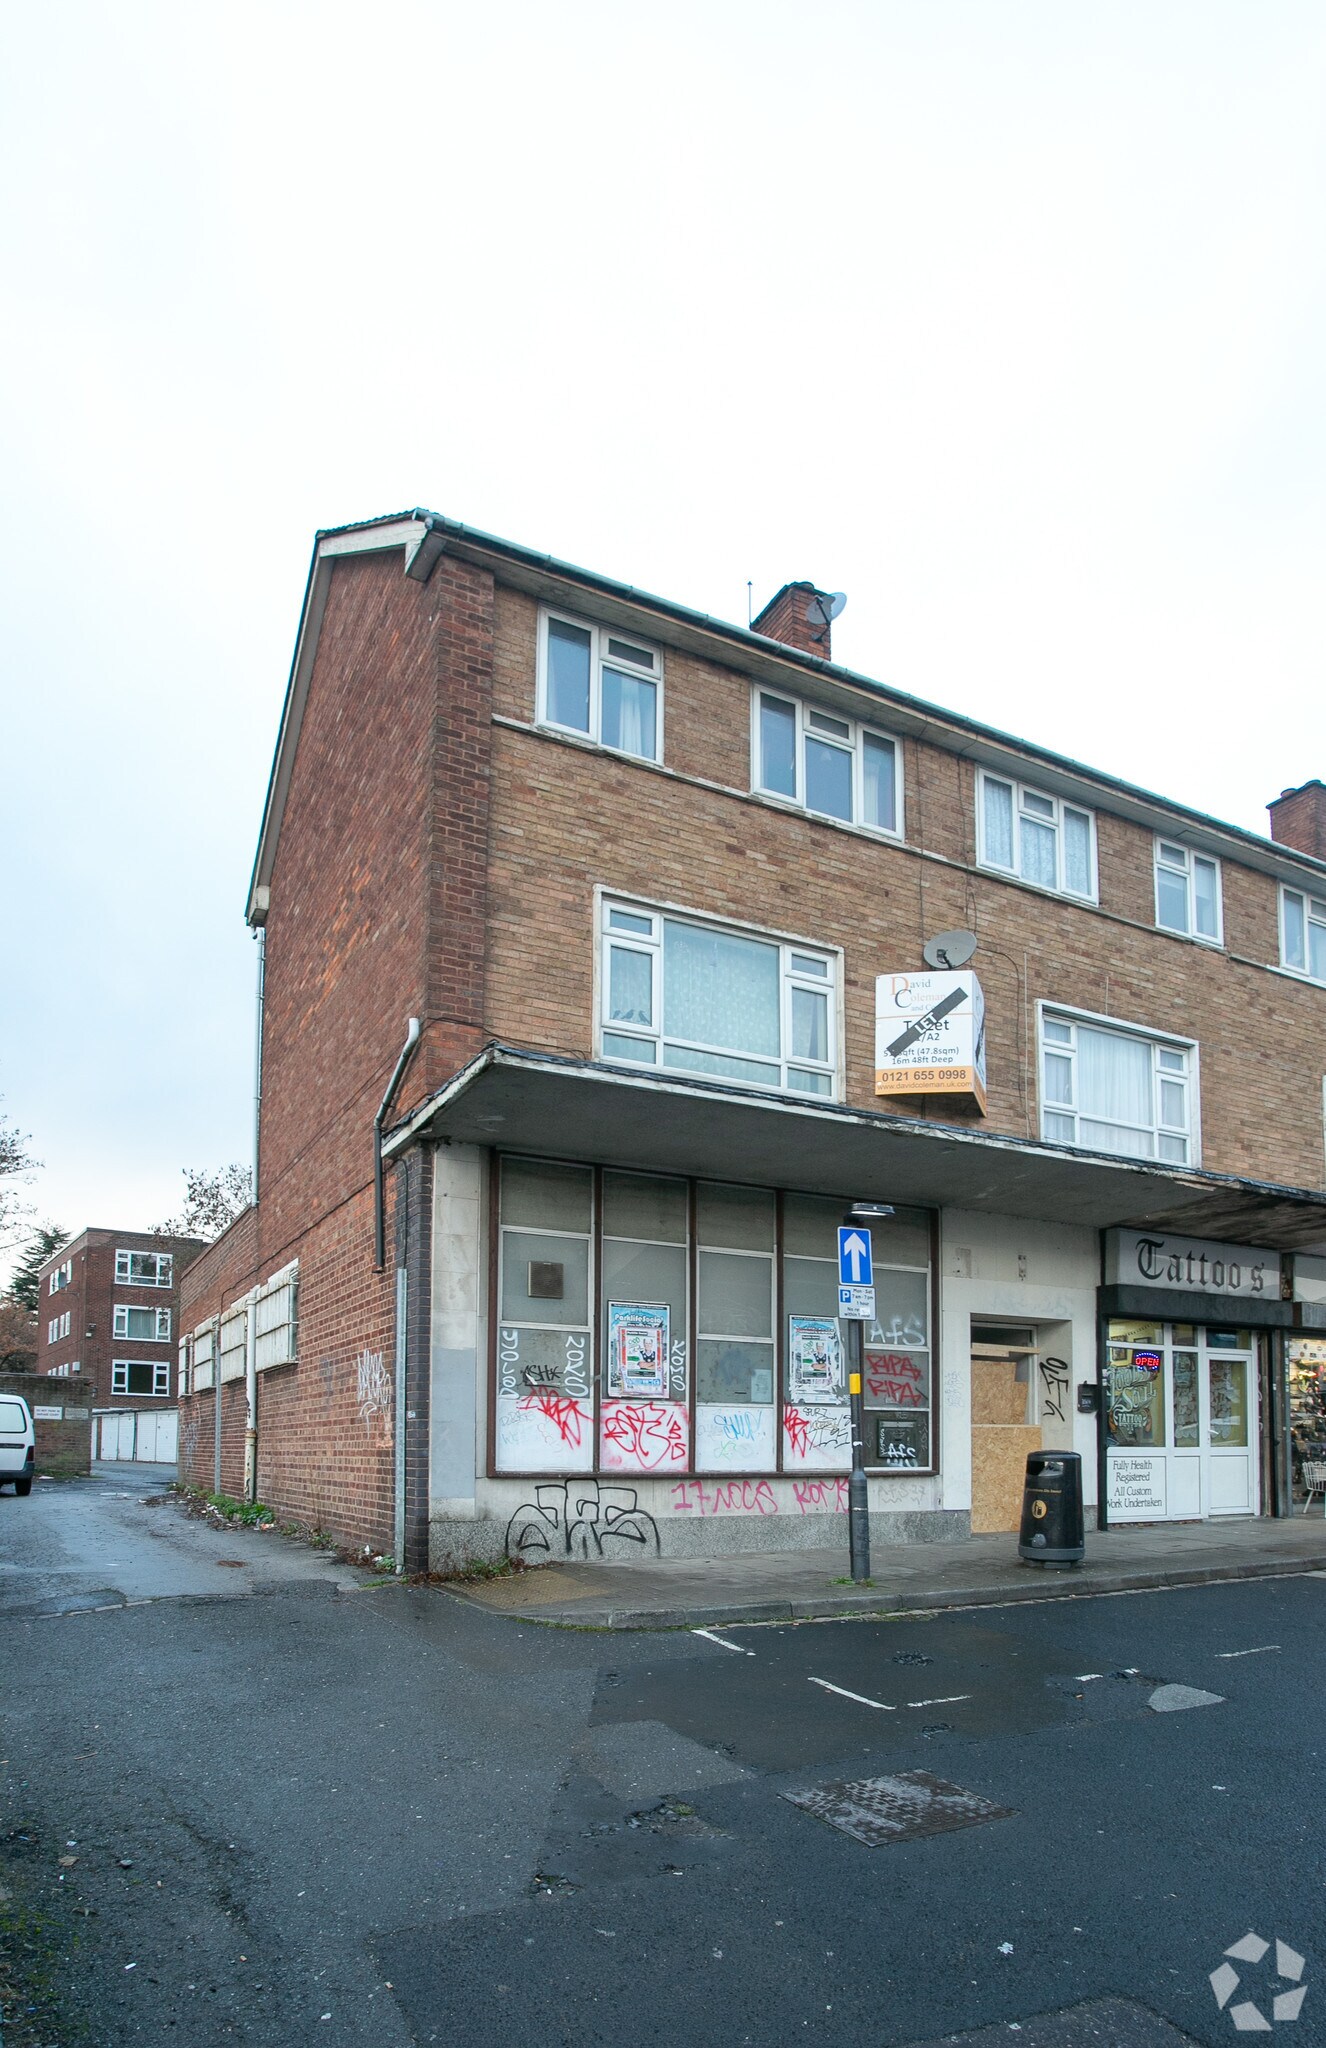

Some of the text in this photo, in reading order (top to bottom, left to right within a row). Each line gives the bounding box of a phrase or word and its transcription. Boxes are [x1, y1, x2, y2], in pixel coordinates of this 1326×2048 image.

[890, 976, 931, 996] David
[914, 1011, 938, 1033] LET
[917, 1046, 960, 1056] (47.8sqm)
[892, 1057, 910, 1065] 16m
[931, 1055, 954, 1064] Deep
[882, 1069, 967, 1082] 0121 655 0998
[1135, 1357, 1159, 1367] OPEN
[1117, 1413, 1143, 1424] TATTOO
[1113, 1460, 1153, 1471] Fully Health
[1116, 1472, 1151, 1484] Registered
[1114, 1486, 1152, 1496] All Custom
[1124, 1498, 1162, 1508] Undertaken
